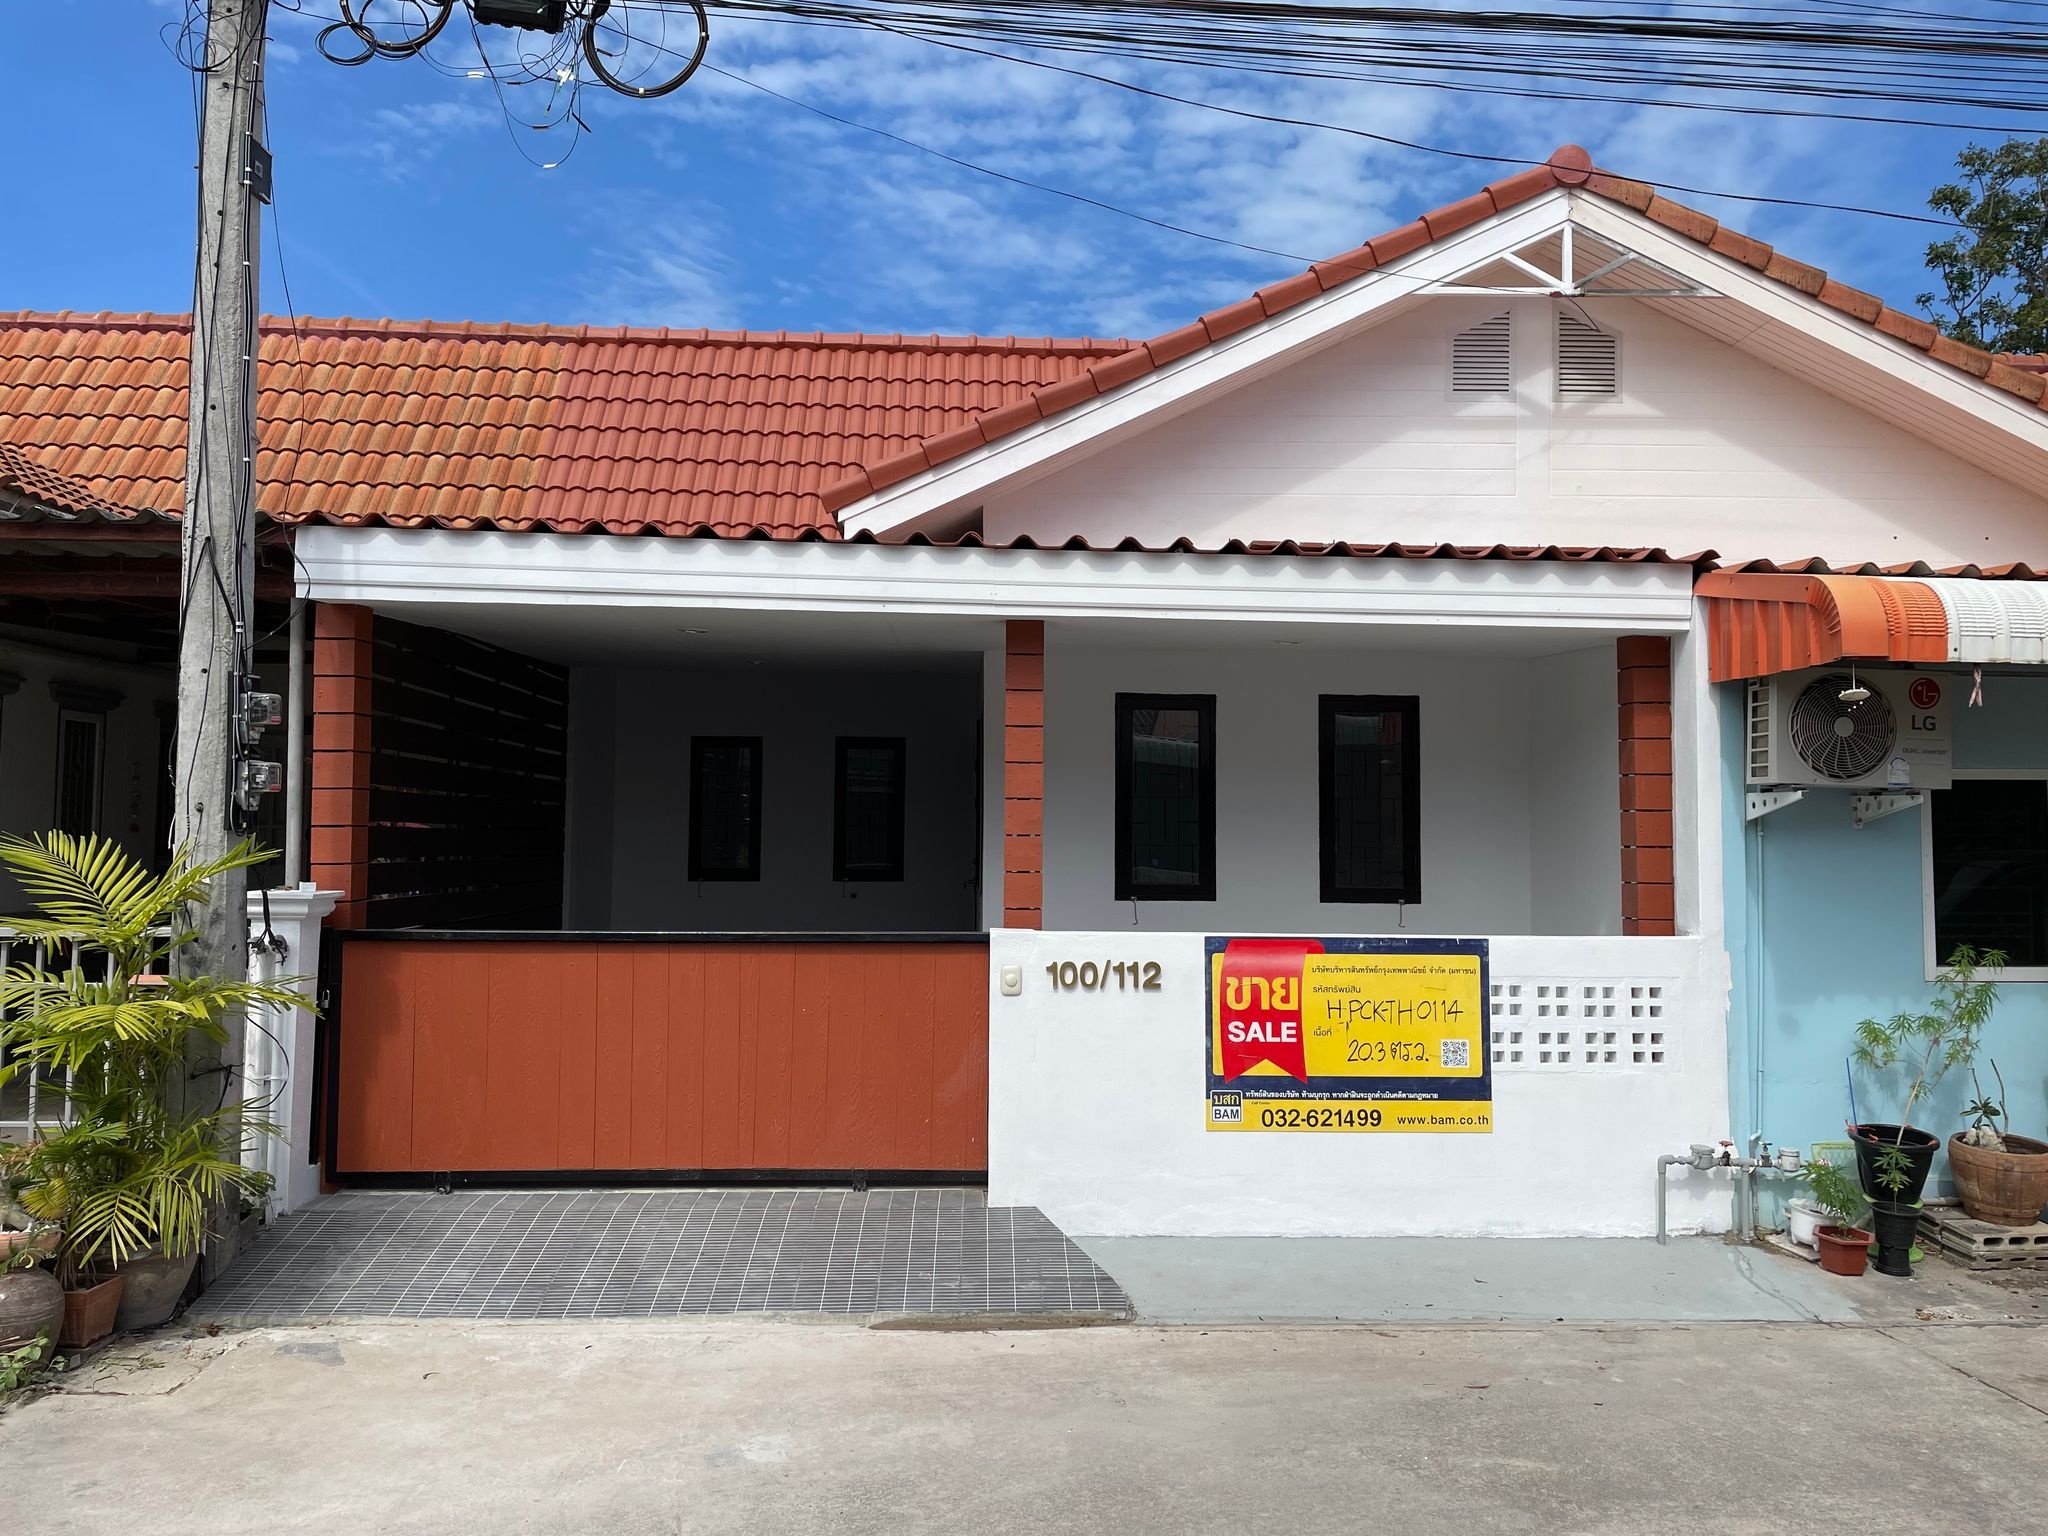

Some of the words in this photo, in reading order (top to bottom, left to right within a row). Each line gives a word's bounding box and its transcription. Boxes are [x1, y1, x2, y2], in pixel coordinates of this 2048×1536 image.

[1911, 714, 1937, 732] LG
[1045, 959, 1162, 990] 100/112
[1226, 976, 1299, 1010] ขาย
[1312, 985, 1361, 993] รหัสทรัพย์สิน
[1227, 1021, 1297, 1043] SALE
[1313, 1026, 1332, 1037] เนื้อที่
[1347, 1039, 1386, 1062] 20.3
[1214, 1094, 1239, 1105] บสก
[1214, 1108, 1239, 1120] BAM
[1262, 1108, 1382, 1128] 032-621499
[1397, 1114, 1489, 1125] www.bam.co.th
